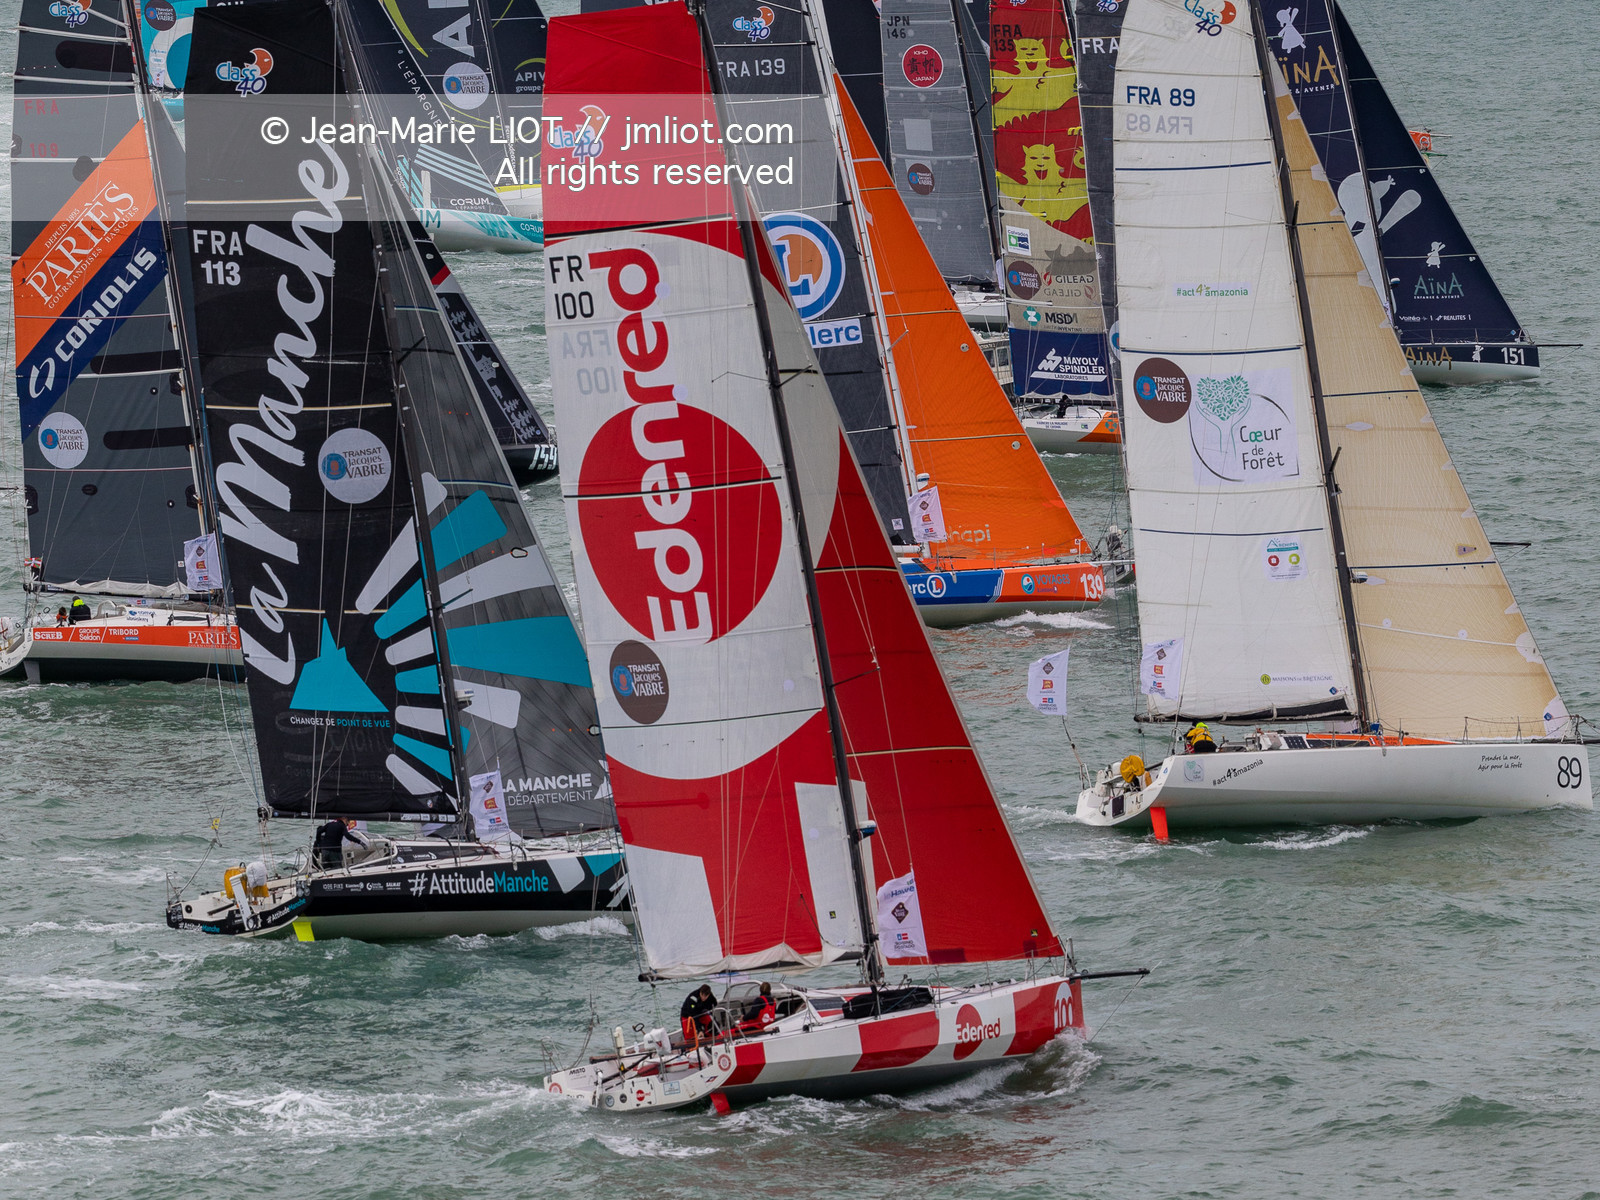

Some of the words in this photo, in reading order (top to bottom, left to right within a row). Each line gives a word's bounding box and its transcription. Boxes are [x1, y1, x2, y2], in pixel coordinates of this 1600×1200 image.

[49, 1, 82, 17] Class
[1096, 0, 1119, 14] 40
[65, 10, 89, 29] 40
[732, 16, 763, 32] Class
[887, 15, 910, 27] JPN
[747, 24, 771, 42] 40
[887, 28, 907, 39] 146
[992, 24, 1023, 39] FRA
[1195, 18, 1223, 38] 40
[992, 39, 1015, 52] 135
[1081, 37, 1119, 55] FRA
[215, 61, 255, 82] Class
[754, 58, 786, 76] 139
[235, 74, 267, 98] 40
[460, 85, 487, 95] VABRE
[515, 84, 541, 94] groupe
[1304, 83, 1335, 93] AVENIR
[1126, 86, 1162, 106] FRA
[1169, 88, 1196, 107] 89
[24, 100, 60, 116] FRA
[29, 142, 59, 158] 109
[449, 197, 490, 206] CORUM
[44, 221, 68, 249] DEPUIS
[66, 208, 81, 228] 1895
[25, 183, 136, 306] PARIÈS
[192, 229, 245, 256] FRA
[48, 246, 103, 310] GOURMANDISES
[104, 205, 140, 245] BASQUES
[201, 259, 242, 287] 113
[54, 247, 158, 363] CORIOLIS
[554, 290, 595, 320] 100
[215, 137, 350, 566] Manche
[1501, 346, 1525, 365] 151
[1063, 356, 1099, 366] MAYOLY
[1059, 364, 1106, 375] SPINDLER
[1153, 376, 1186, 384] TRANSAT
[1157, 382, 1186, 392] Jacques
[1155, 391, 1188, 403] VABRE
[58, 433, 83, 442] Jacques
[1239, 425, 1282, 443] Cœur
[57, 440, 86, 451] VABRE
[341, 446, 383, 459] TRANSAT
[588, 247, 714, 646] Edenred
[1252, 443, 1264, 456] de
[345, 454, 383, 467] Jacques
[1242, 451, 1285, 471] Forêt
[344, 463, 387, 479] VABRE
[1034, 573, 1071, 585] VOYAGES
[1080, 573, 1104, 600] 139
[108, 628, 139, 636] TRIBORD
[242, 562, 297, 686] La
[627, 663, 661, 673] TRANSAT
[632, 671, 662, 684] Jacques
[631, 681, 666, 698] VABRE
[290, 716, 324, 726] CHANGEZ
[325, 718, 336, 727] DE
[337, 718, 361, 728] POINT
[362, 719, 373, 728] DE
[375, 720, 391, 728] VUE
[1490, 764, 1503, 772] pour
[1557, 755, 1582, 789] 89
[519, 773, 593, 792] MANCHE
[507, 789, 593, 807] DÉPARTEMENT
[407, 868, 549, 898] #AttitudeManche
[954, 1017, 1001, 1044] Edenred
